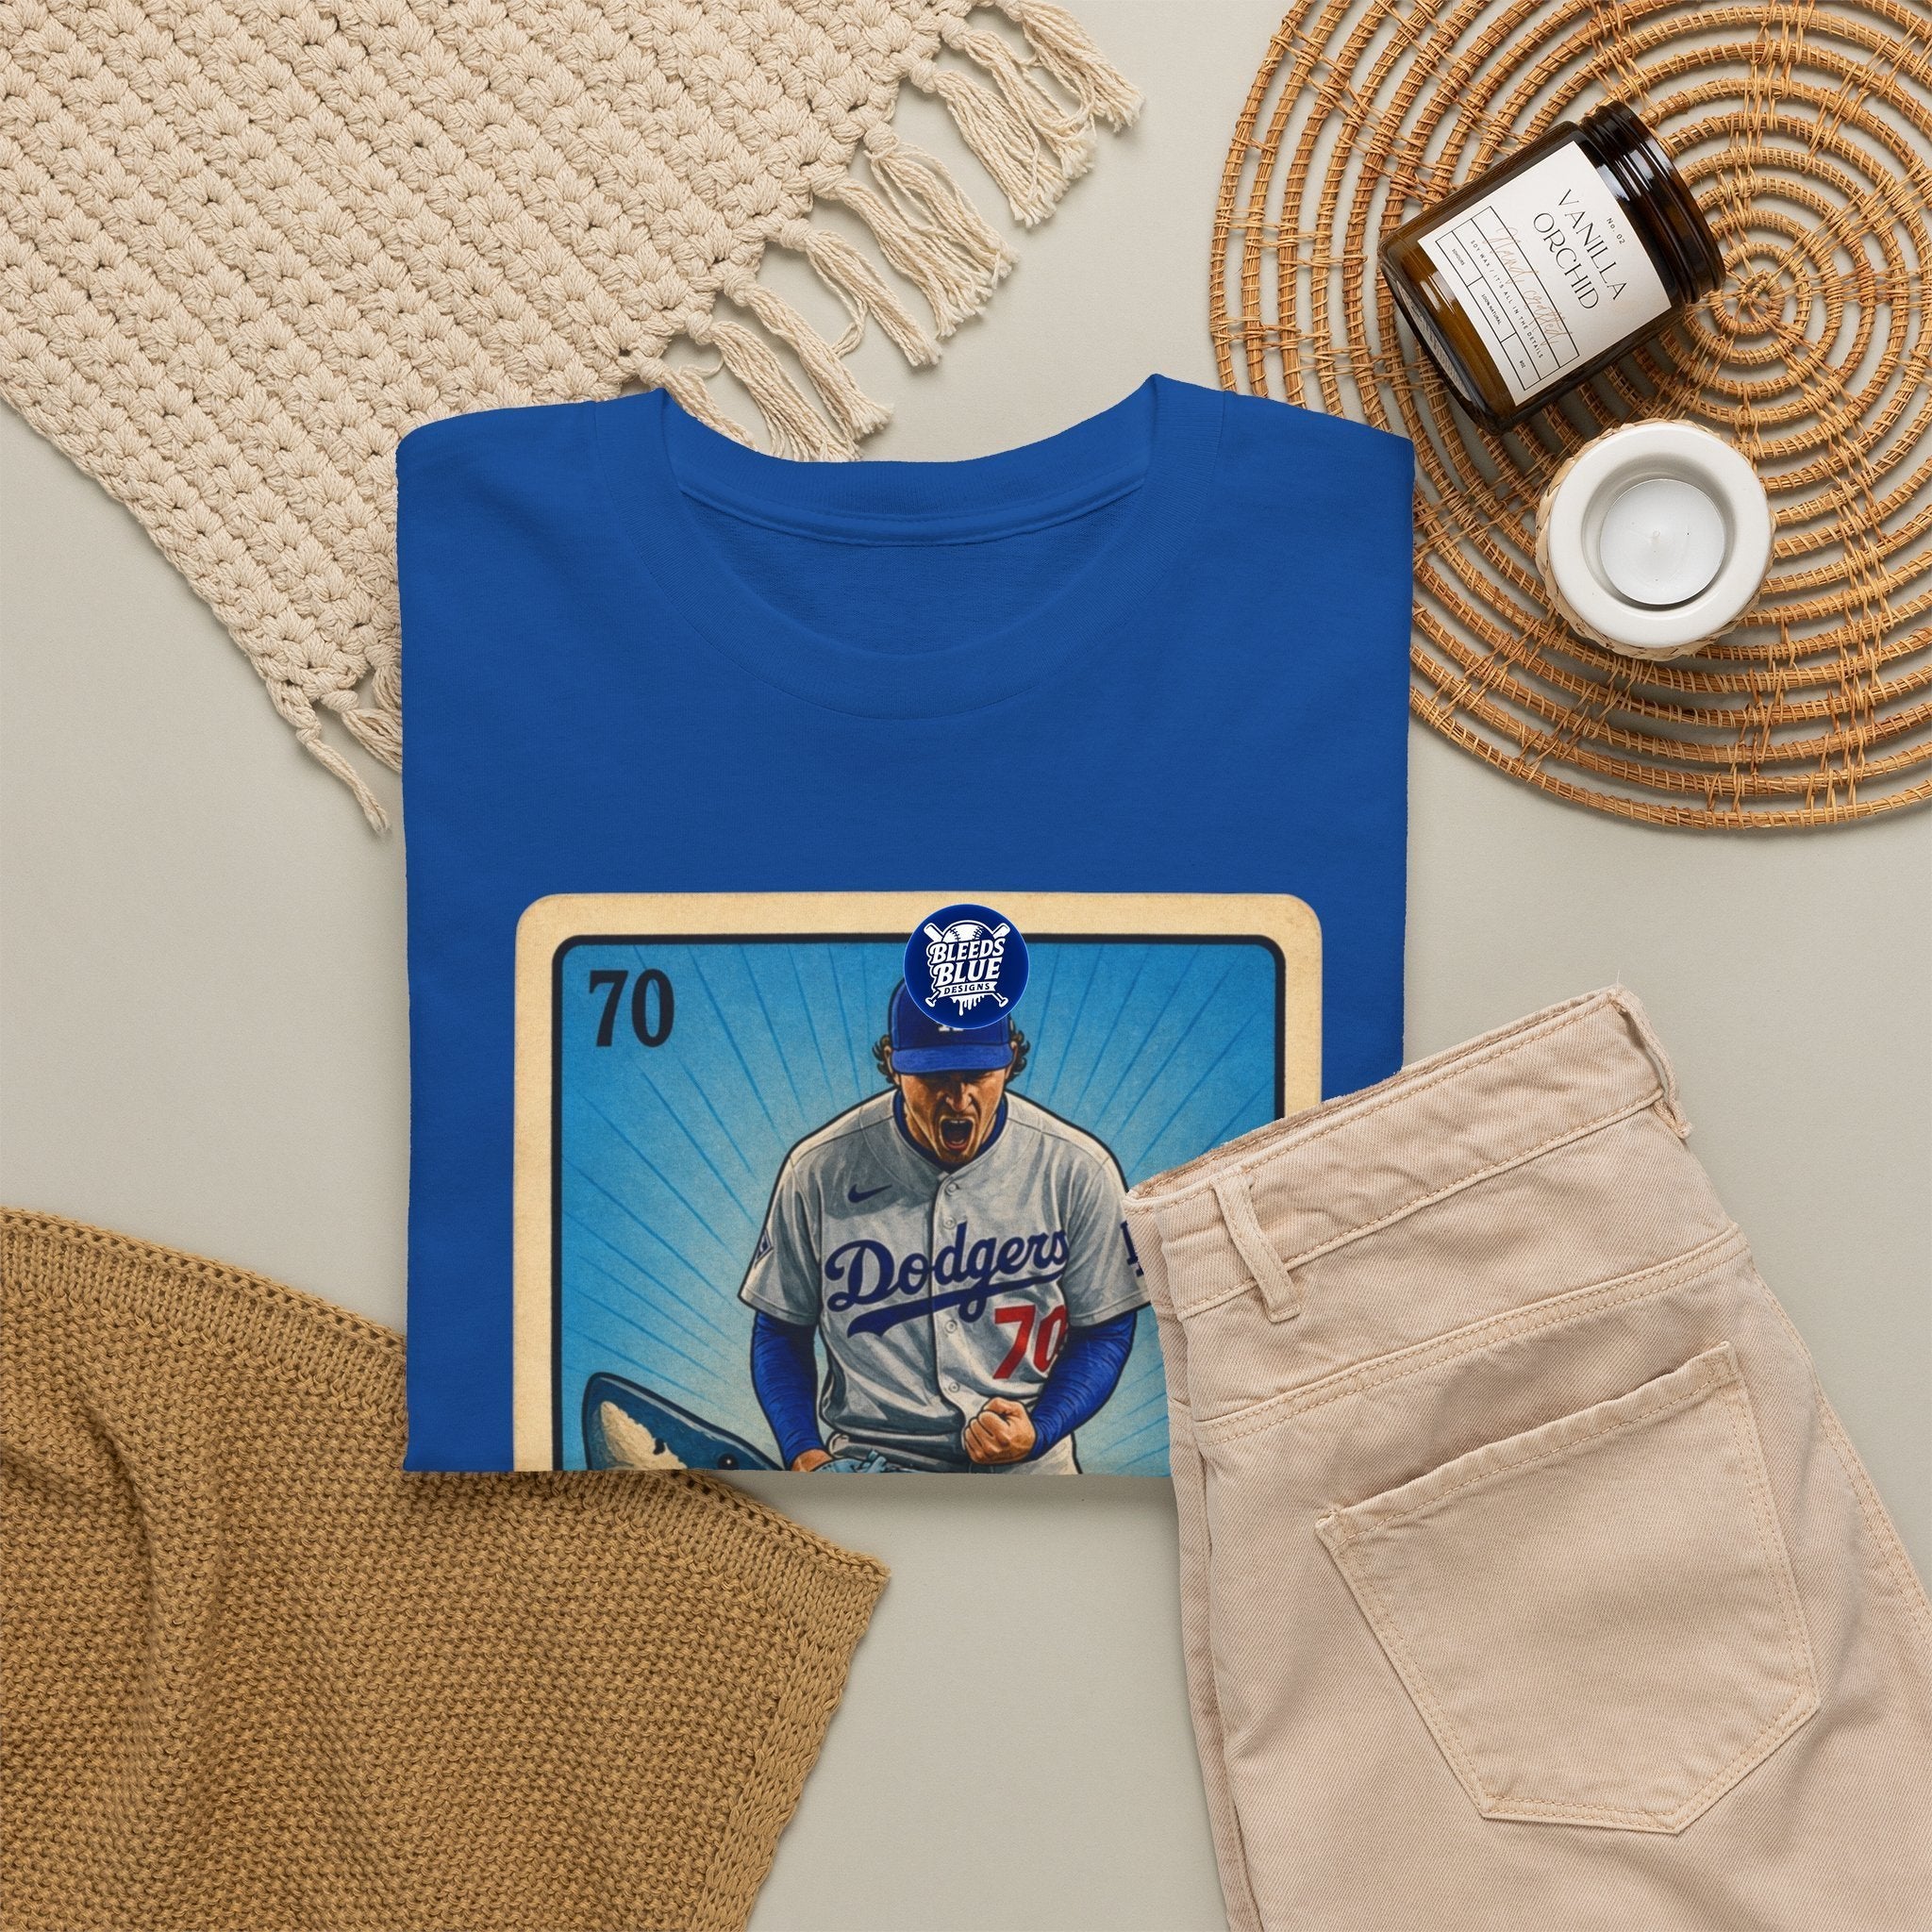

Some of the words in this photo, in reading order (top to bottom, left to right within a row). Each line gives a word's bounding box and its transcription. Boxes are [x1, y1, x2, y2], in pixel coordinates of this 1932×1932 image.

[1533, 212, 1599, 308] ORCHID
[1558, 189, 1627, 300] VANILLA
[1607, 217, 1616, 232] No.
[1616, 234, 1625, 244] 02
[1471, 240, 1480, 251] SOY
[1480, 254, 1490, 267] WAX
[1494, 275, 1504, 289] IT'S
[1504, 290, 1513, 304] ALL
[1512, 306, 1519, 314] IN
[1519, 316, 1528, 330] THE
[1526, 331, 1543, 358] DETAILS
[1489, 305, 1502, 325] NATURAL
[589, 968, 675, 1048] 70
[825, 1221, 1069, 1324] Dodgers
[992, 1304, 1068, 1380] 70
